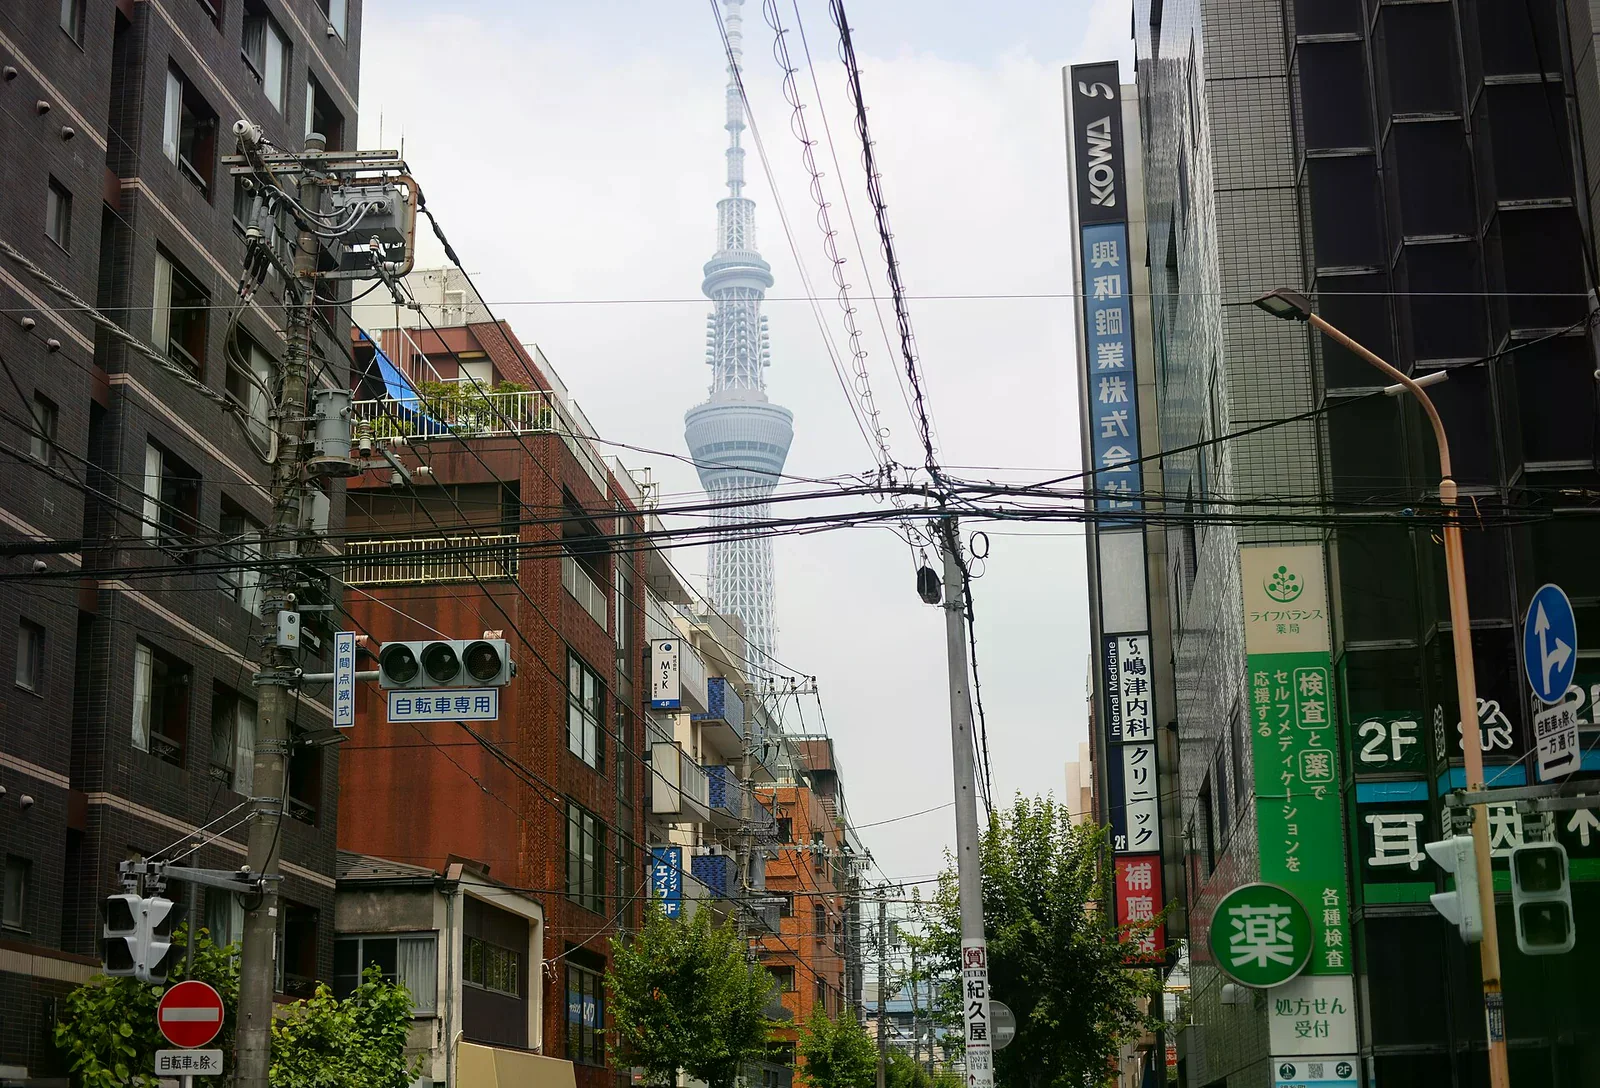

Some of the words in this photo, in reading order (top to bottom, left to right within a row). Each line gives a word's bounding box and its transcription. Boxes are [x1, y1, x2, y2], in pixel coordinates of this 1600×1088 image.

[1086, 116, 1116, 207] KOWA
[1091, 240, 1134, 508] 興和鋼業株式会社
[1250, 609, 1323, 622] ライフバランス
[1276, 623, 1300, 635] 薬局
[338, 641, 351, 717] 夜間点滅式
[660, 661, 671, 690] MSK
[1108, 641, 1118, 691] Medicine
[396, 696, 490, 715] 自転車専用
[1110, 693, 1121, 736] Internal
[1123, 657, 1151, 738] 嶋津内科
[1253, 670, 1272, 737] 応援する
[1358, 720, 1418, 762] 2F
[1537, 710, 1575, 736] 自転車を除く
[1540, 731, 1575, 755] 一方通行
[1273, 669, 1301, 872] セルフメディケーションを
[1130, 747, 1154, 846] クリニック
[1115, 835, 1126, 850] 2F
[656, 865, 668, 899] エイワ
[1228, 903, 1294, 968] 薬
[1322, 887, 1344, 968] 各種検査
[967, 980, 987, 1041] 紀久屋
[1275, 998, 1347, 1017] 処方せん
[1295, 1020, 1330, 1038] 受付
[160, 1056, 218, 1070] 自転車を除く
[1337, 1066, 1351, 1075] 2F
